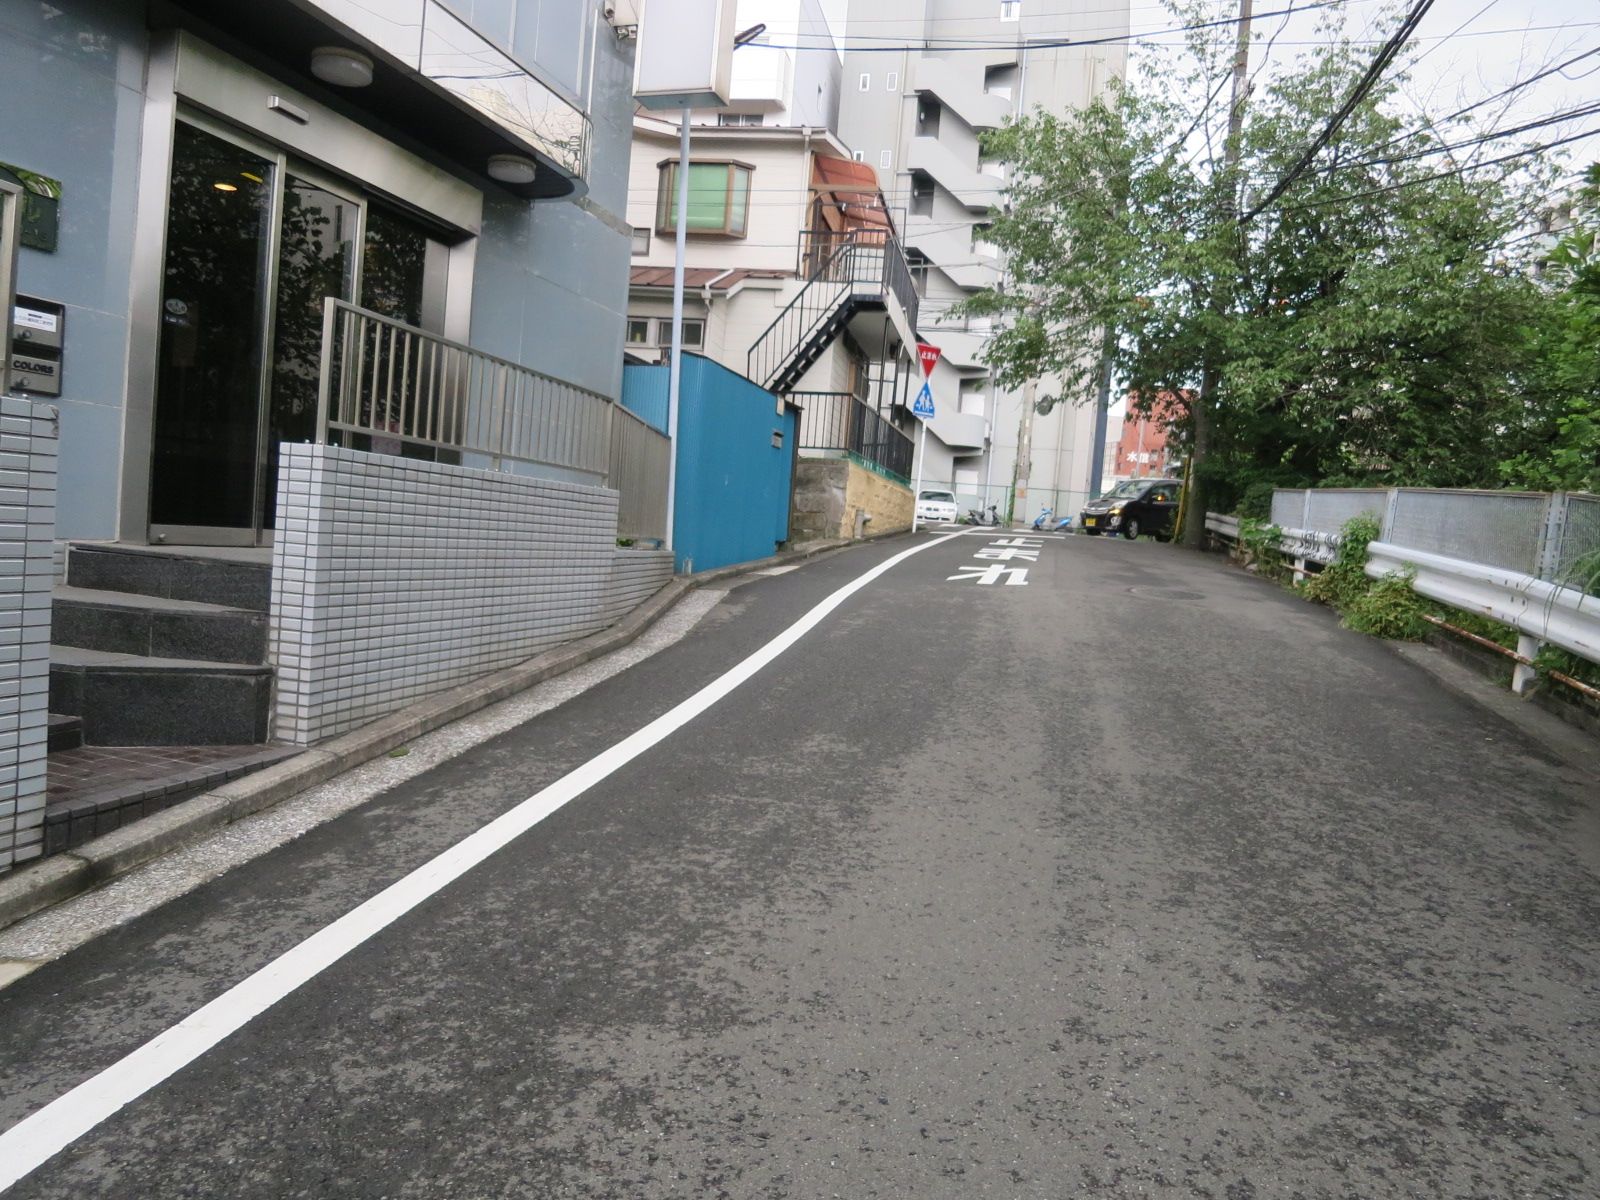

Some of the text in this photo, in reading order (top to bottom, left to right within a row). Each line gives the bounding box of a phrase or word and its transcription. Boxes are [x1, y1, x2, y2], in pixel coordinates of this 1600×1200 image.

[921, 350, 937, 361] 止まれ
[13, 360, 54, 375] COLORS
[946, 538, 1045, 586] 止まれ
